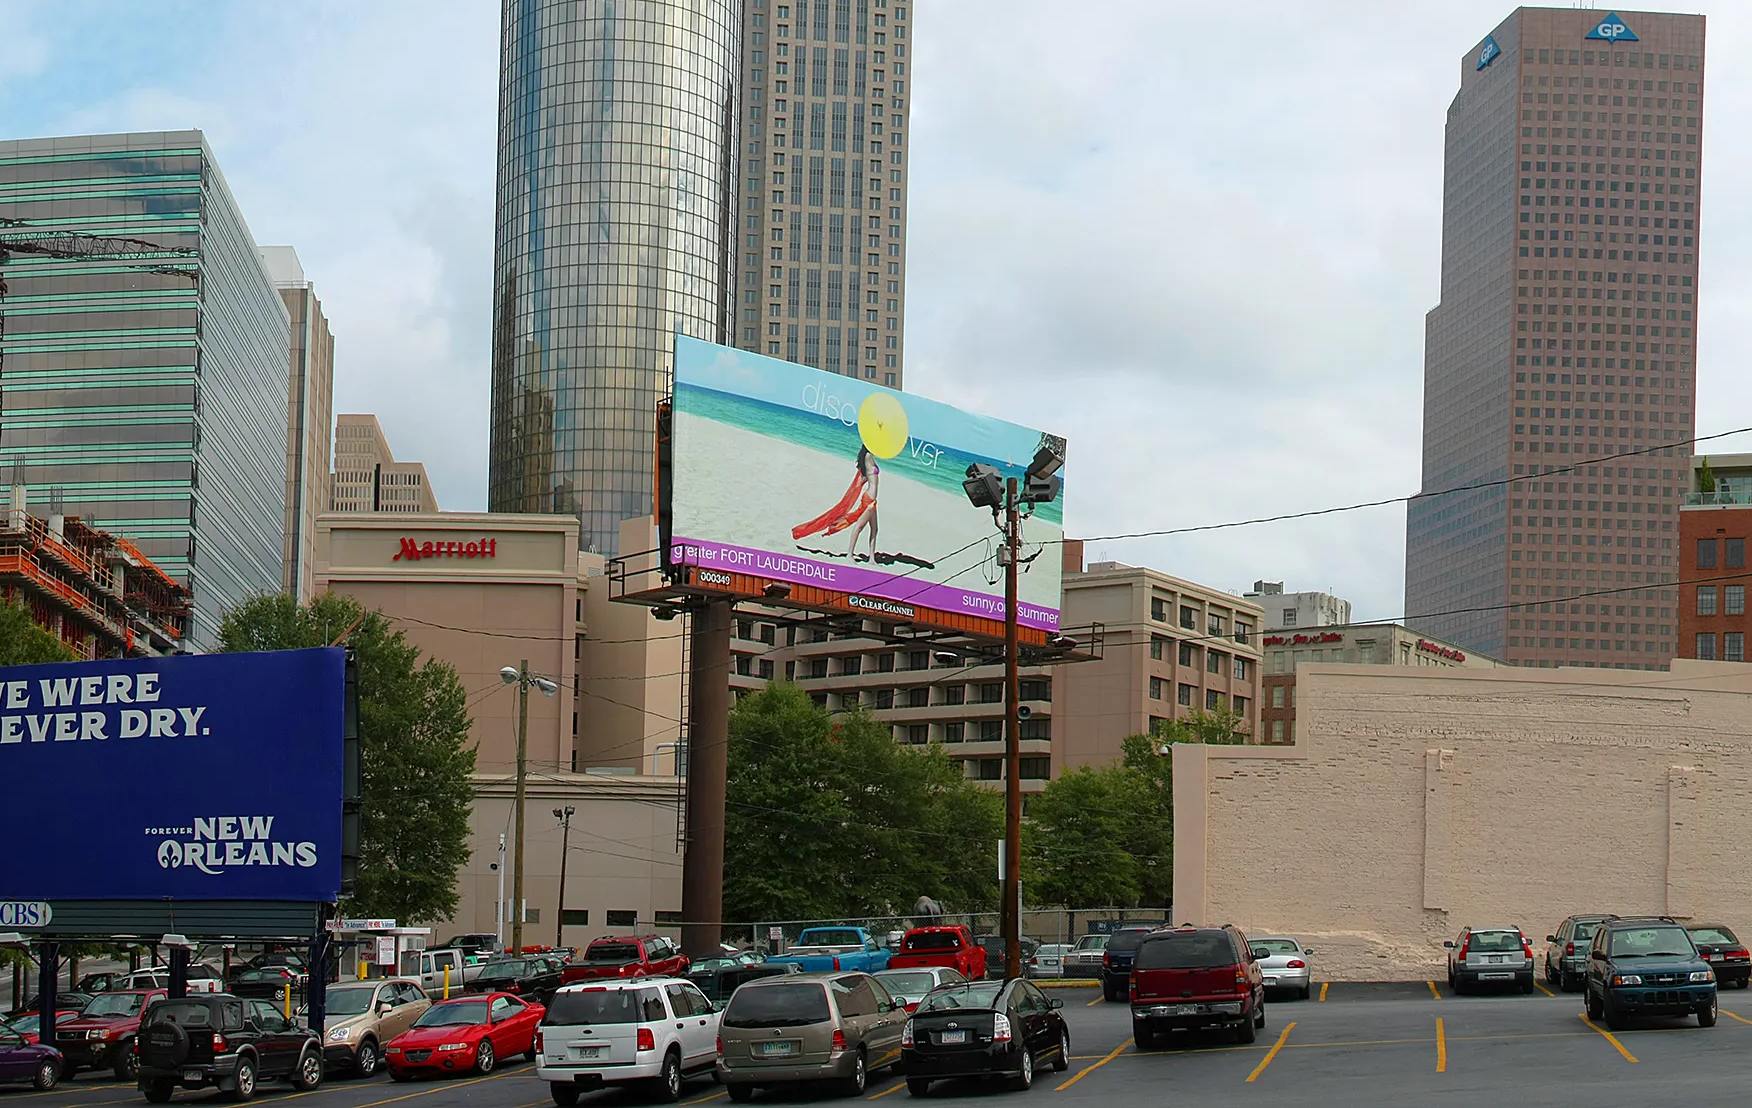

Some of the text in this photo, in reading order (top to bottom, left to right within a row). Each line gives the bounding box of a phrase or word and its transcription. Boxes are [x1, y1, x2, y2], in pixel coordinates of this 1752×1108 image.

[1598, 23, 1626, 37] GP
[1480, 43, 1494, 62] GP
[393, 538, 497, 561] Marriott
[674, 544, 836, 582] greater FORT LAUDERDALE
[700, 572, 731, 585] 000349
[39, 673, 161, 708] WERE
[119, 706, 210, 739] DRY.
[145, 816, 274, 840] FOREVER NEW
[158, 839, 318, 875] ORLEANS
[0, 903, 39, 925] CBS
